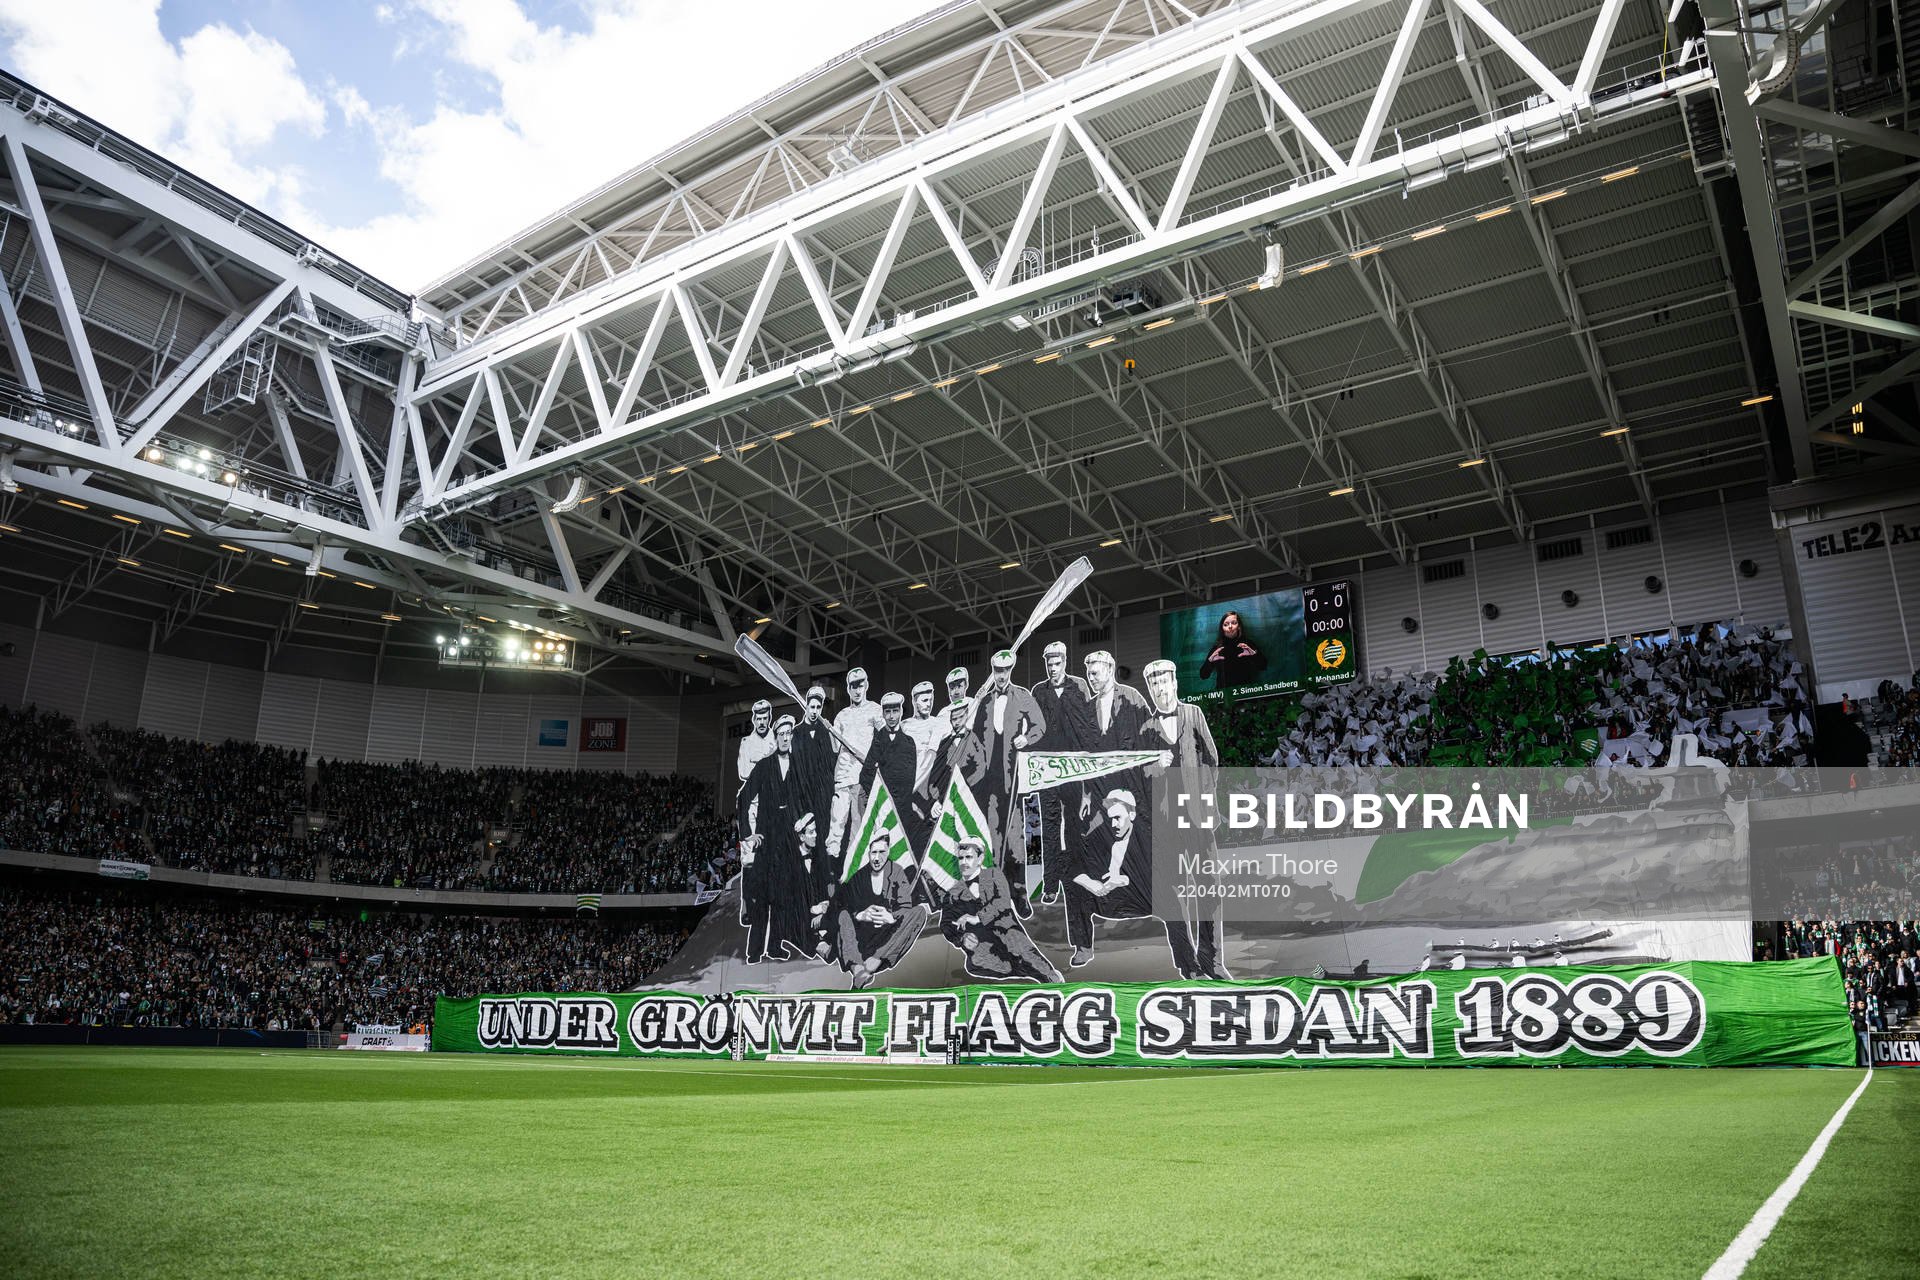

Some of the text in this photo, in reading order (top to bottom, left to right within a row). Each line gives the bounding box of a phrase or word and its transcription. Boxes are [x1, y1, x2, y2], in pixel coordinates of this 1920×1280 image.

[1802, 521, 1885, 559] TELE2
[1304, 582, 1347, 597] HIF HEIF
[1309, 598, 1318, 612] 0
[1334, 594, 1343, 608] 0
[1312, 617, 1344, 633] 00:00
[1315, 671, 1350, 683] Mohanad
[1232, 680, 1299, 696] 2. Simon Sandberg
[590, 722, 614, 737] JOB
[588, 739, 616, 749] ZONE
[1048, 757, 1099, 778] SPURT
[478, 999, 619, 1051] UNDER
[886, 989, 1120, 1058] FLAGG
[1136, 980, 1436, 1058] SEDAN
[1455, 971, 1705, 1057] 1889
[361, 1037, 388, 1046] CRAFT
[1872, 1040, 1920, 1062] ICKEN
